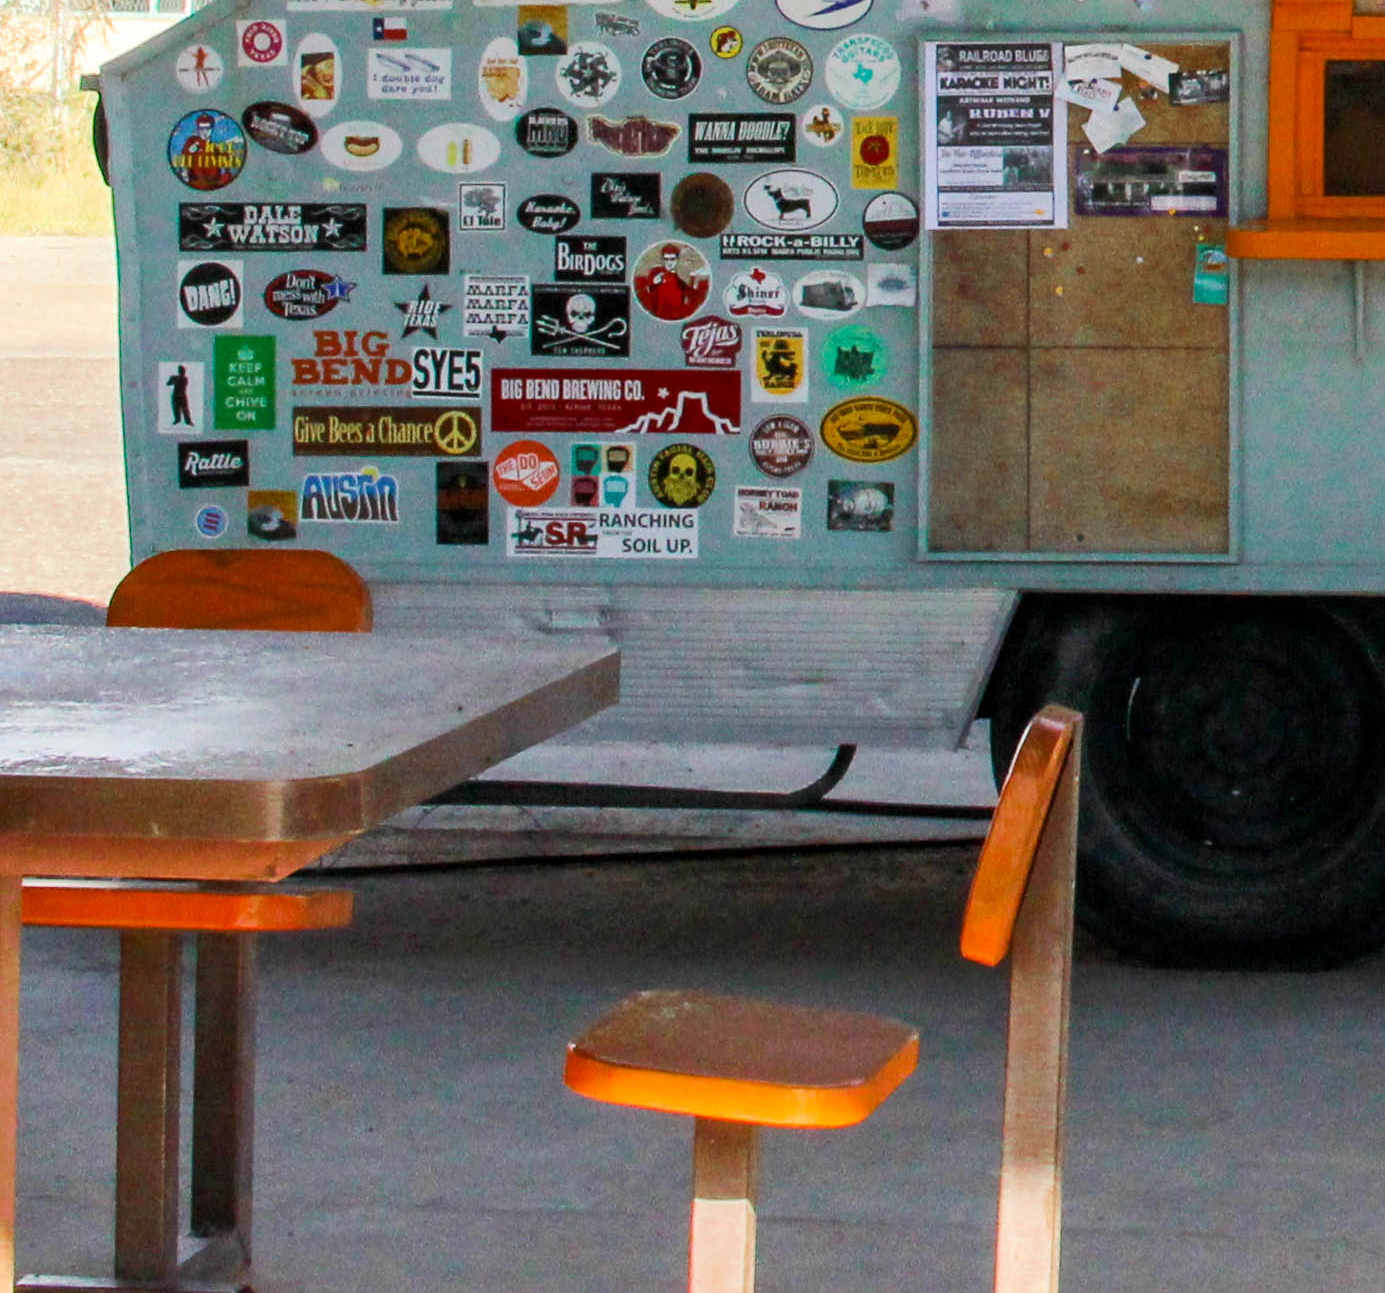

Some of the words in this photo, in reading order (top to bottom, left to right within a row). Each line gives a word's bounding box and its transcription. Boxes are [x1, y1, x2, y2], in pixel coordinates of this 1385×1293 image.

[959, 50, 1012, 62] RAILROAD
[940, 77, 999, 89] KARAOKE
[694, 122, 735, 141] WANNA
[243, 205, 300, 224] DALE
[227, 224, 320, 244] WATSON
[184, 278, 236, 312] DANG!
[466, 285, 529, 296] MARFA
[282, 302, 317, 316] Texas
[409, 300, 441, 314] RIDE
[466, 299, 529, 310] MARFA
[404, 314, 438, 328] TEXAS
[466, 314, 529, 324] MARFA
[313, 330, 390, 357] BIG
[682, 323, 739, 356] Tejas
[229, 363, 262, 372] KEEP
[292, 359, 412, 385] BEND
[227, 376, 265, 386] CALM
[501, 379, 523, 400] BIG
[526, 379, 560, 400] BEND
[562, 379, 621, 400] BREWING
[624, 380, 645, 401] CO.
[225, 397, 267, 407] CHIVE
[236, 411, 256, 420] ON
[294, 417, 325, 443] Give
[328, 417, 362, 443] Bees
[366, 425, 374, 443] a
[378, 417, 433, 443] Chance
[519, 456, 537, 469] DO
[599, 513, 694, 528] RANCHING
[622, 539, 661, 553] SOIL
[666, 539, 692, 553] UP.
